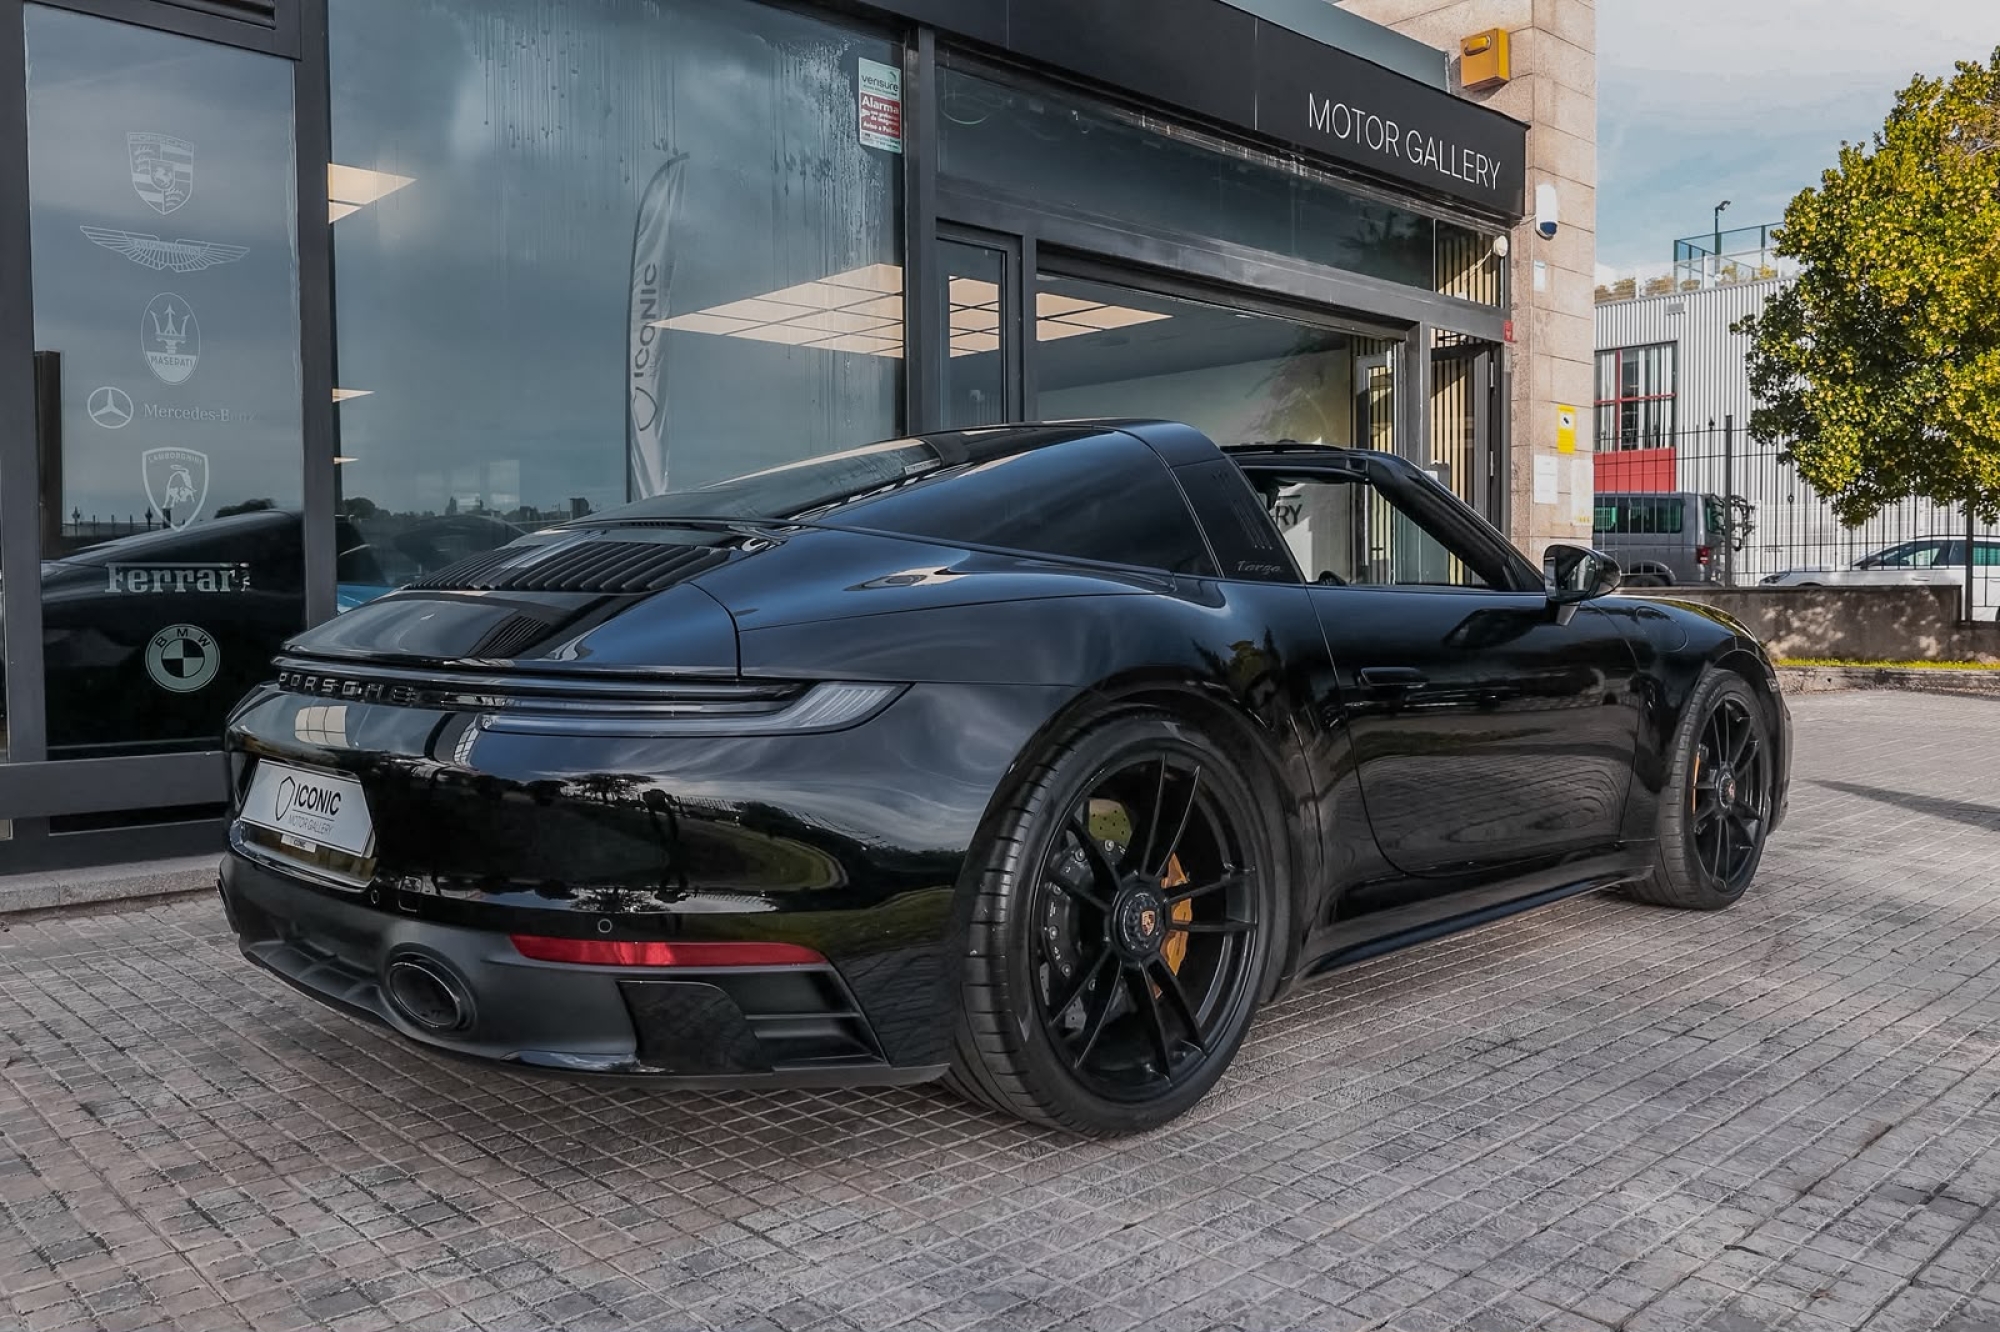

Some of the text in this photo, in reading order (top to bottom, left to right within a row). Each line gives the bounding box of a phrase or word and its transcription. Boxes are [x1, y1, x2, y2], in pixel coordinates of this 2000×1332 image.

[862, 95, 900, 113] Alarma
[1308, 92, 1501, 191] MOTOR GALLERY
[634, 263, 657, 378] ICONIC
[150, 355, 194, 367] MASERATI
[1238, 560, 1281, 575] Targa
[154, 627, 211, 648] BMW
[279, 672, 413, 703] PORSCHE
[293, 783, 342, 816] ICONIC
